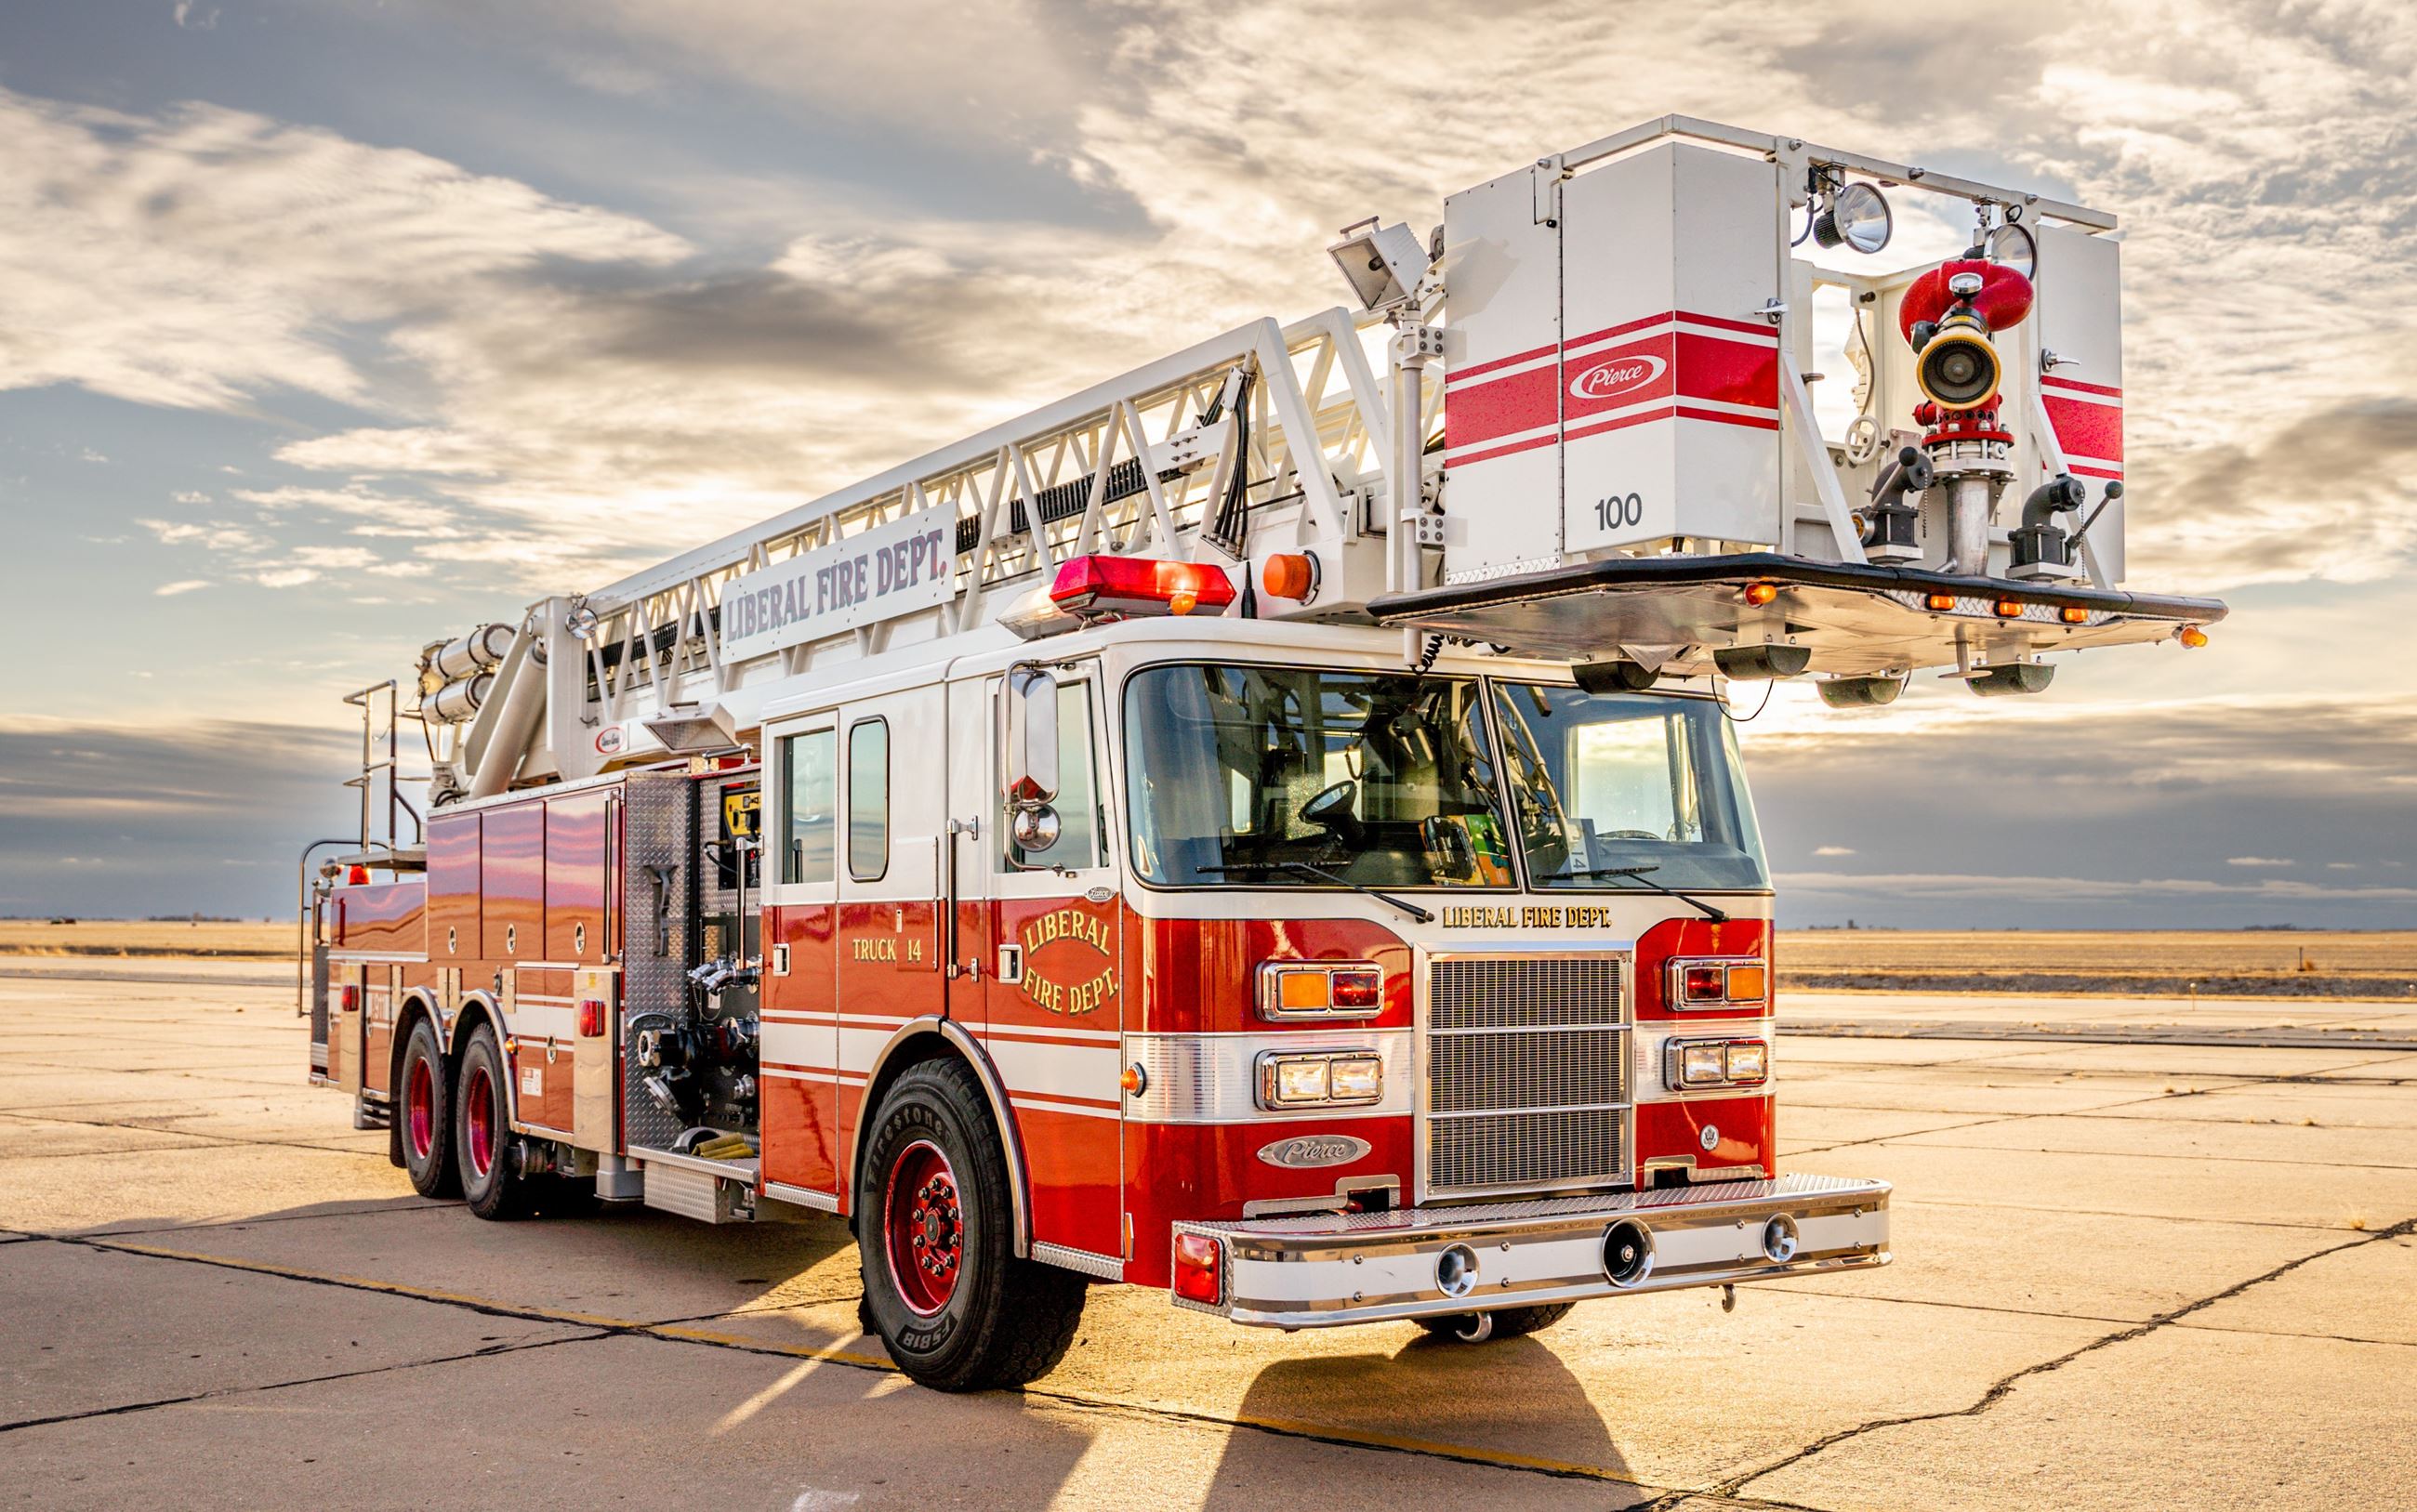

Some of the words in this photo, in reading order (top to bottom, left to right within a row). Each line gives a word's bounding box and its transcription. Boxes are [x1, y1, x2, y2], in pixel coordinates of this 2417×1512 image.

[1588, 364, 1644, 393] Pierce
[1594, 493, 1642, 531] 100
[726, 575, 811, 643] LIBERAL
[816, 554, 868, 615] FIRE
[876, 528, 947, 598] DEPT.
[1024, 910, 1111, 956] LIBERAL
[1443, 906, 1518, 928] LIBERAL
[1522, 906, 1562, 928] FIRE
[1565, 906, 1613, 928] DEPT.
[852, 938, 896, 963] TRUCK
[906, 938, 922, 963] 14
[1023, 966, 1063, 1014] FIRE
[1068, 966, 1119, 1016] DEPT.
[1282, 1139, 1347, 1164] Pierce
